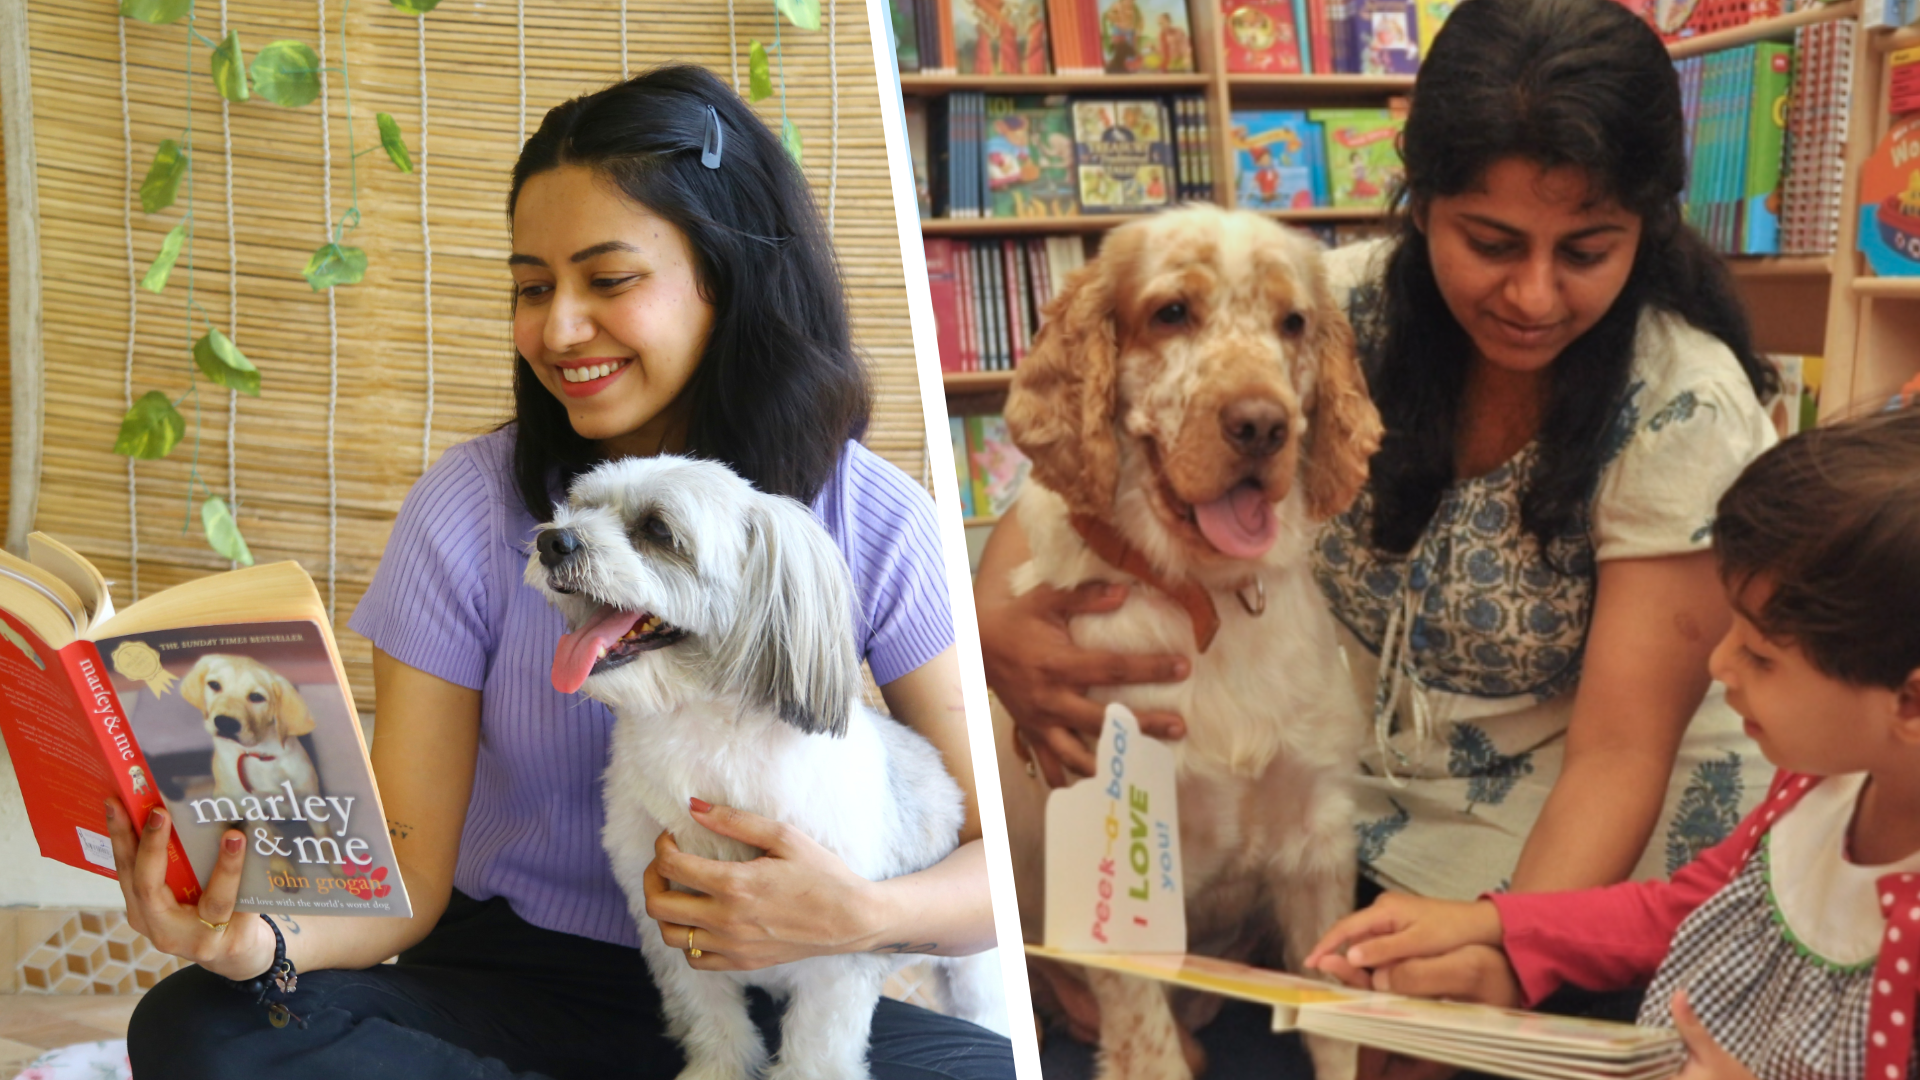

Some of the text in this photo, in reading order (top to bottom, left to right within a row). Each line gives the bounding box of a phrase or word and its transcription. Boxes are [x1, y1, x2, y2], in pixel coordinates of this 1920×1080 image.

[159, 633, 304, 651] THE SUNDAY TIMES BESTSELLER
[79, 658, 135, 761] marley & me
[190, 779, 355, 837] marley
[254, 827, 373, 865] & me
[1128, 784, 1149, 927] I LOVE
[1156, 821, 1175, 892] you!
[240, 896, 390, 911] and love with the world's worst dog
[266, 870, 383, 895] john grogan
